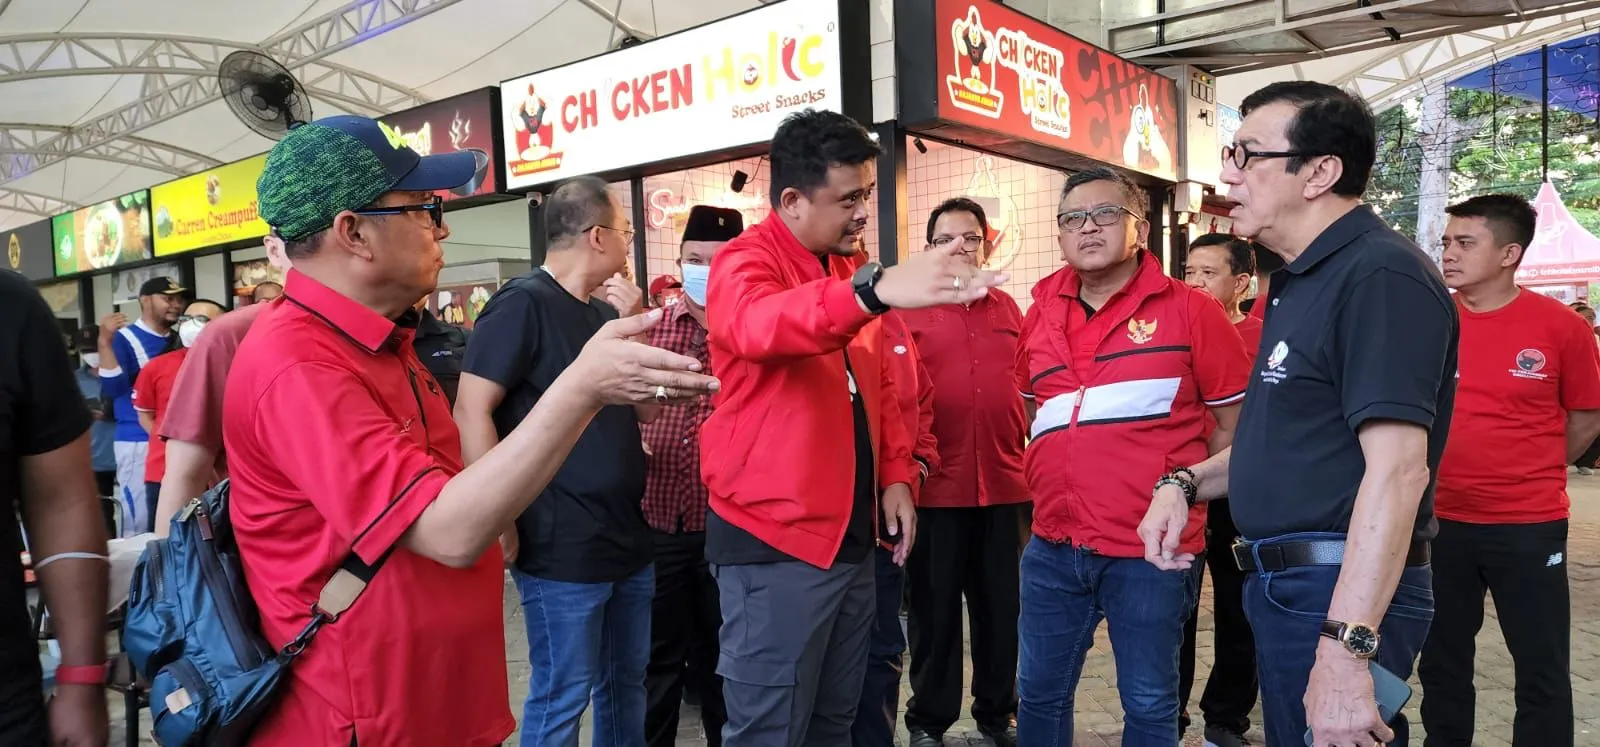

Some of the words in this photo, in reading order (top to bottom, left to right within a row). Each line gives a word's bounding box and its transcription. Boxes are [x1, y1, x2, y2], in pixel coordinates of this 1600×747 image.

[561, 64, 693, 133] CHCKEN
[731, 101, 771, 120] Street
[775, 88, 826, 110] Snacks
